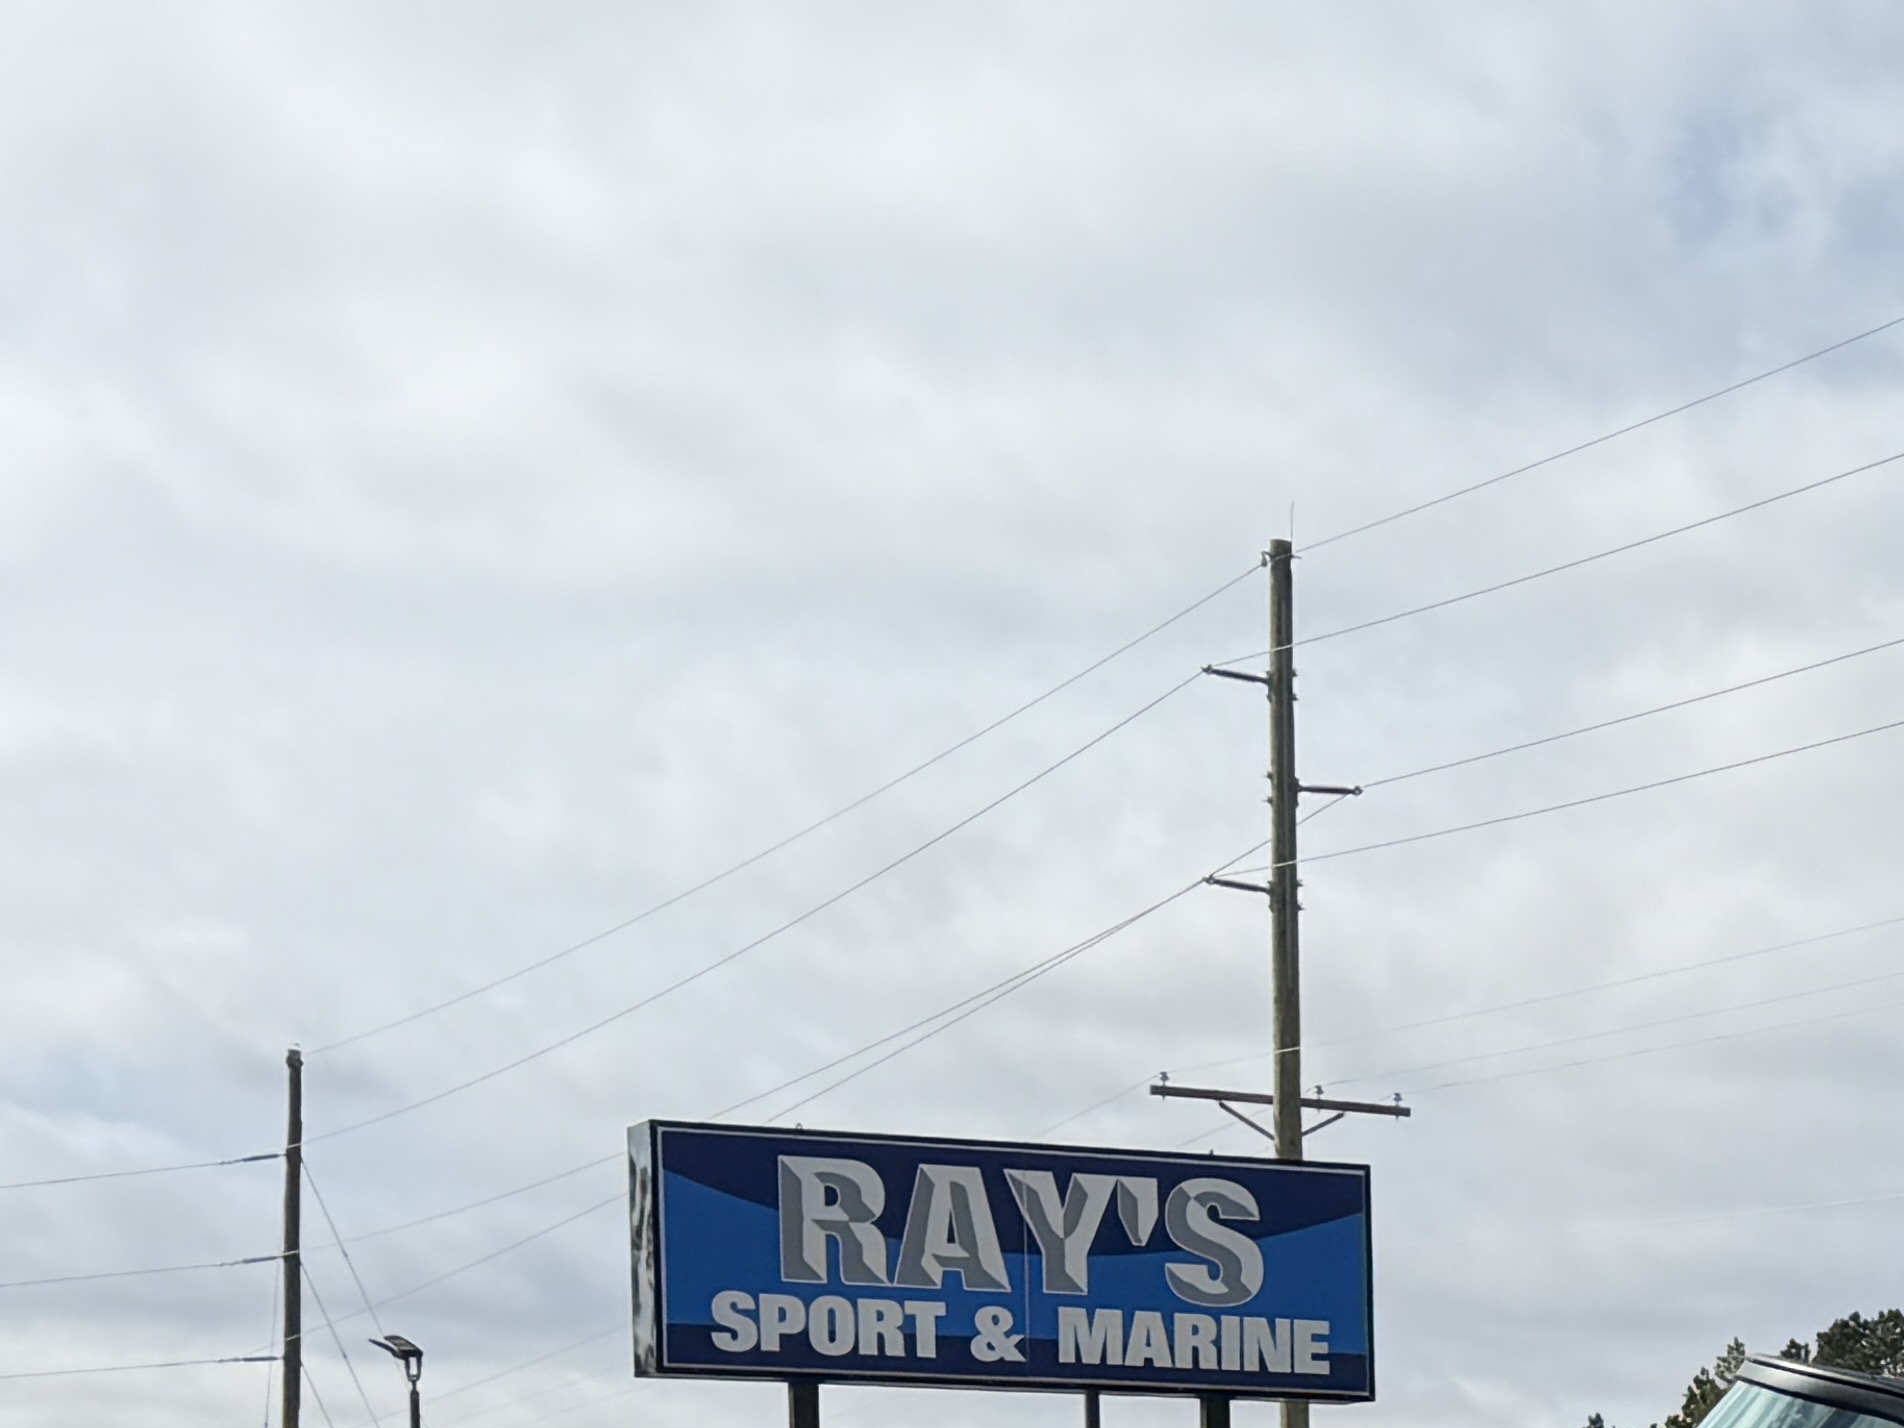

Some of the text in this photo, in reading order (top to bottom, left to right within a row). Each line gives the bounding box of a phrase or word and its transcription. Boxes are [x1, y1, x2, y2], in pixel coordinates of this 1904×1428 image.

[778, 1154, 1266, 1308] RAY'S
[711, 1291, 1331, 1376] SPORT & MARINE
